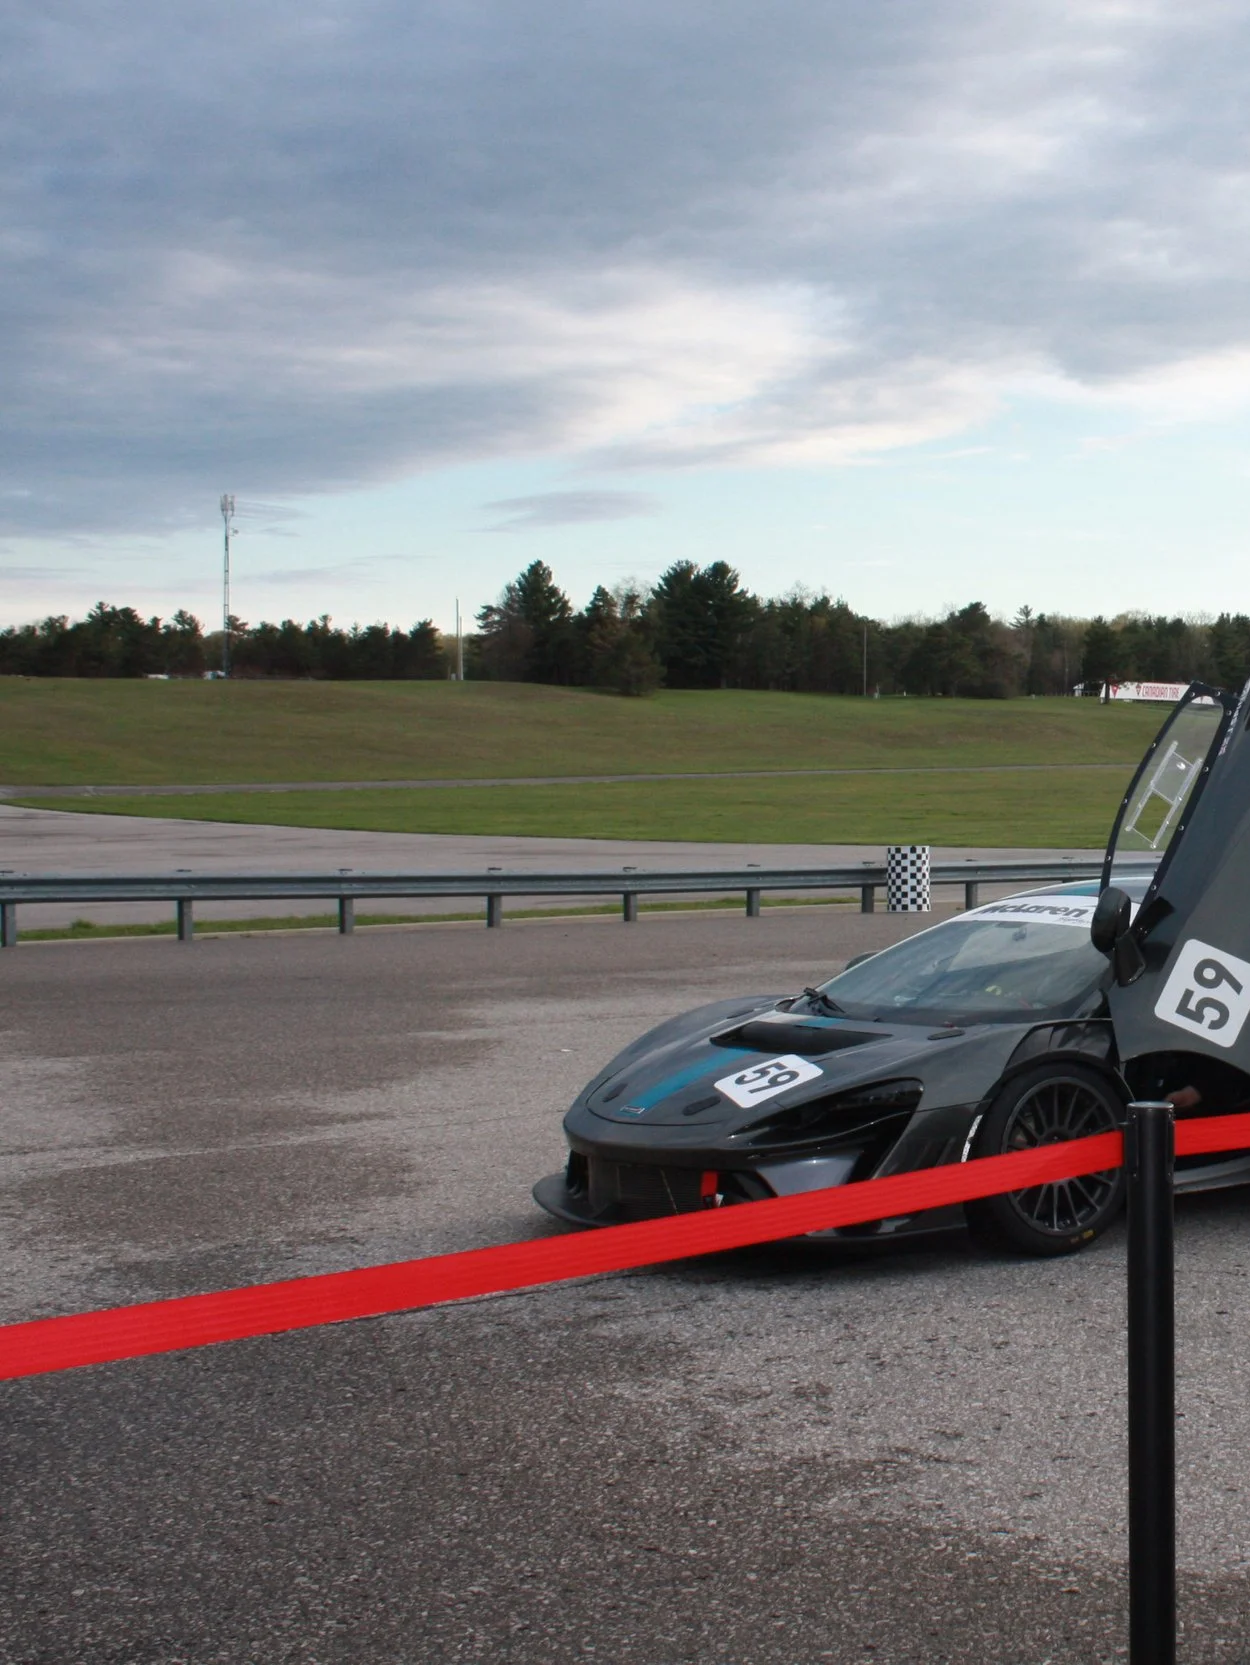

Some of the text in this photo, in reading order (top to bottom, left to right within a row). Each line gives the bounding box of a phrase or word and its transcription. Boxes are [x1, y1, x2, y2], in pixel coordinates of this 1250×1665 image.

[1142, 685, 1180, 699] CANADIAN TIRE
[972, 903, 1089, 918] McLaren
[1175, 958, 1243, 1030] 59
[734, 1061, 800, 1094] 59
